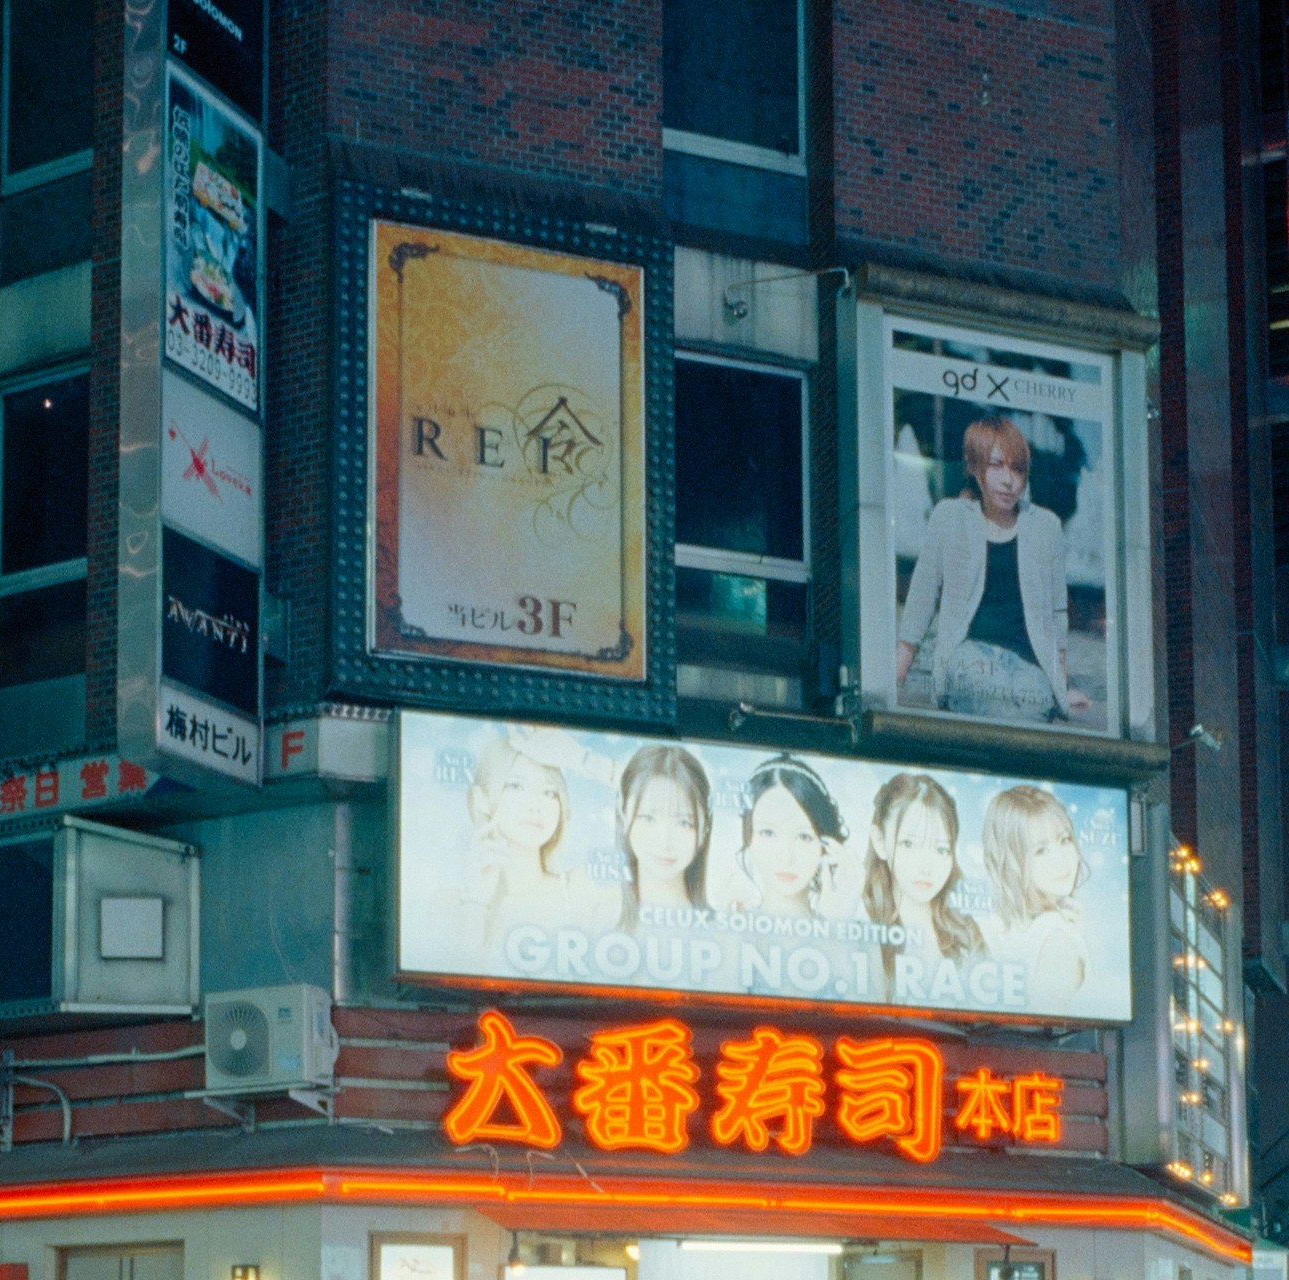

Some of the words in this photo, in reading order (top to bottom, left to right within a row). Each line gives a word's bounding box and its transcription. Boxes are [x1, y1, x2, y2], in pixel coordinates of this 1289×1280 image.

[169, 293, 256, 380] 大番寿司
[1014, 379, 1077, 401] CHERRY
[515, 595, 577, 639] 3F
[165, 704, 252, 766] 梅村ビル
[639, 906, 708, 930] CELUX
[506, 925, 722, 983] GROUP
[742, 942, 870, 995] NO.1
[895, 954, 1027, 1006] RACE
[444, 1010, 943, 1163] 大番寿司
[954, 1068, 1064, 1144] 本店
